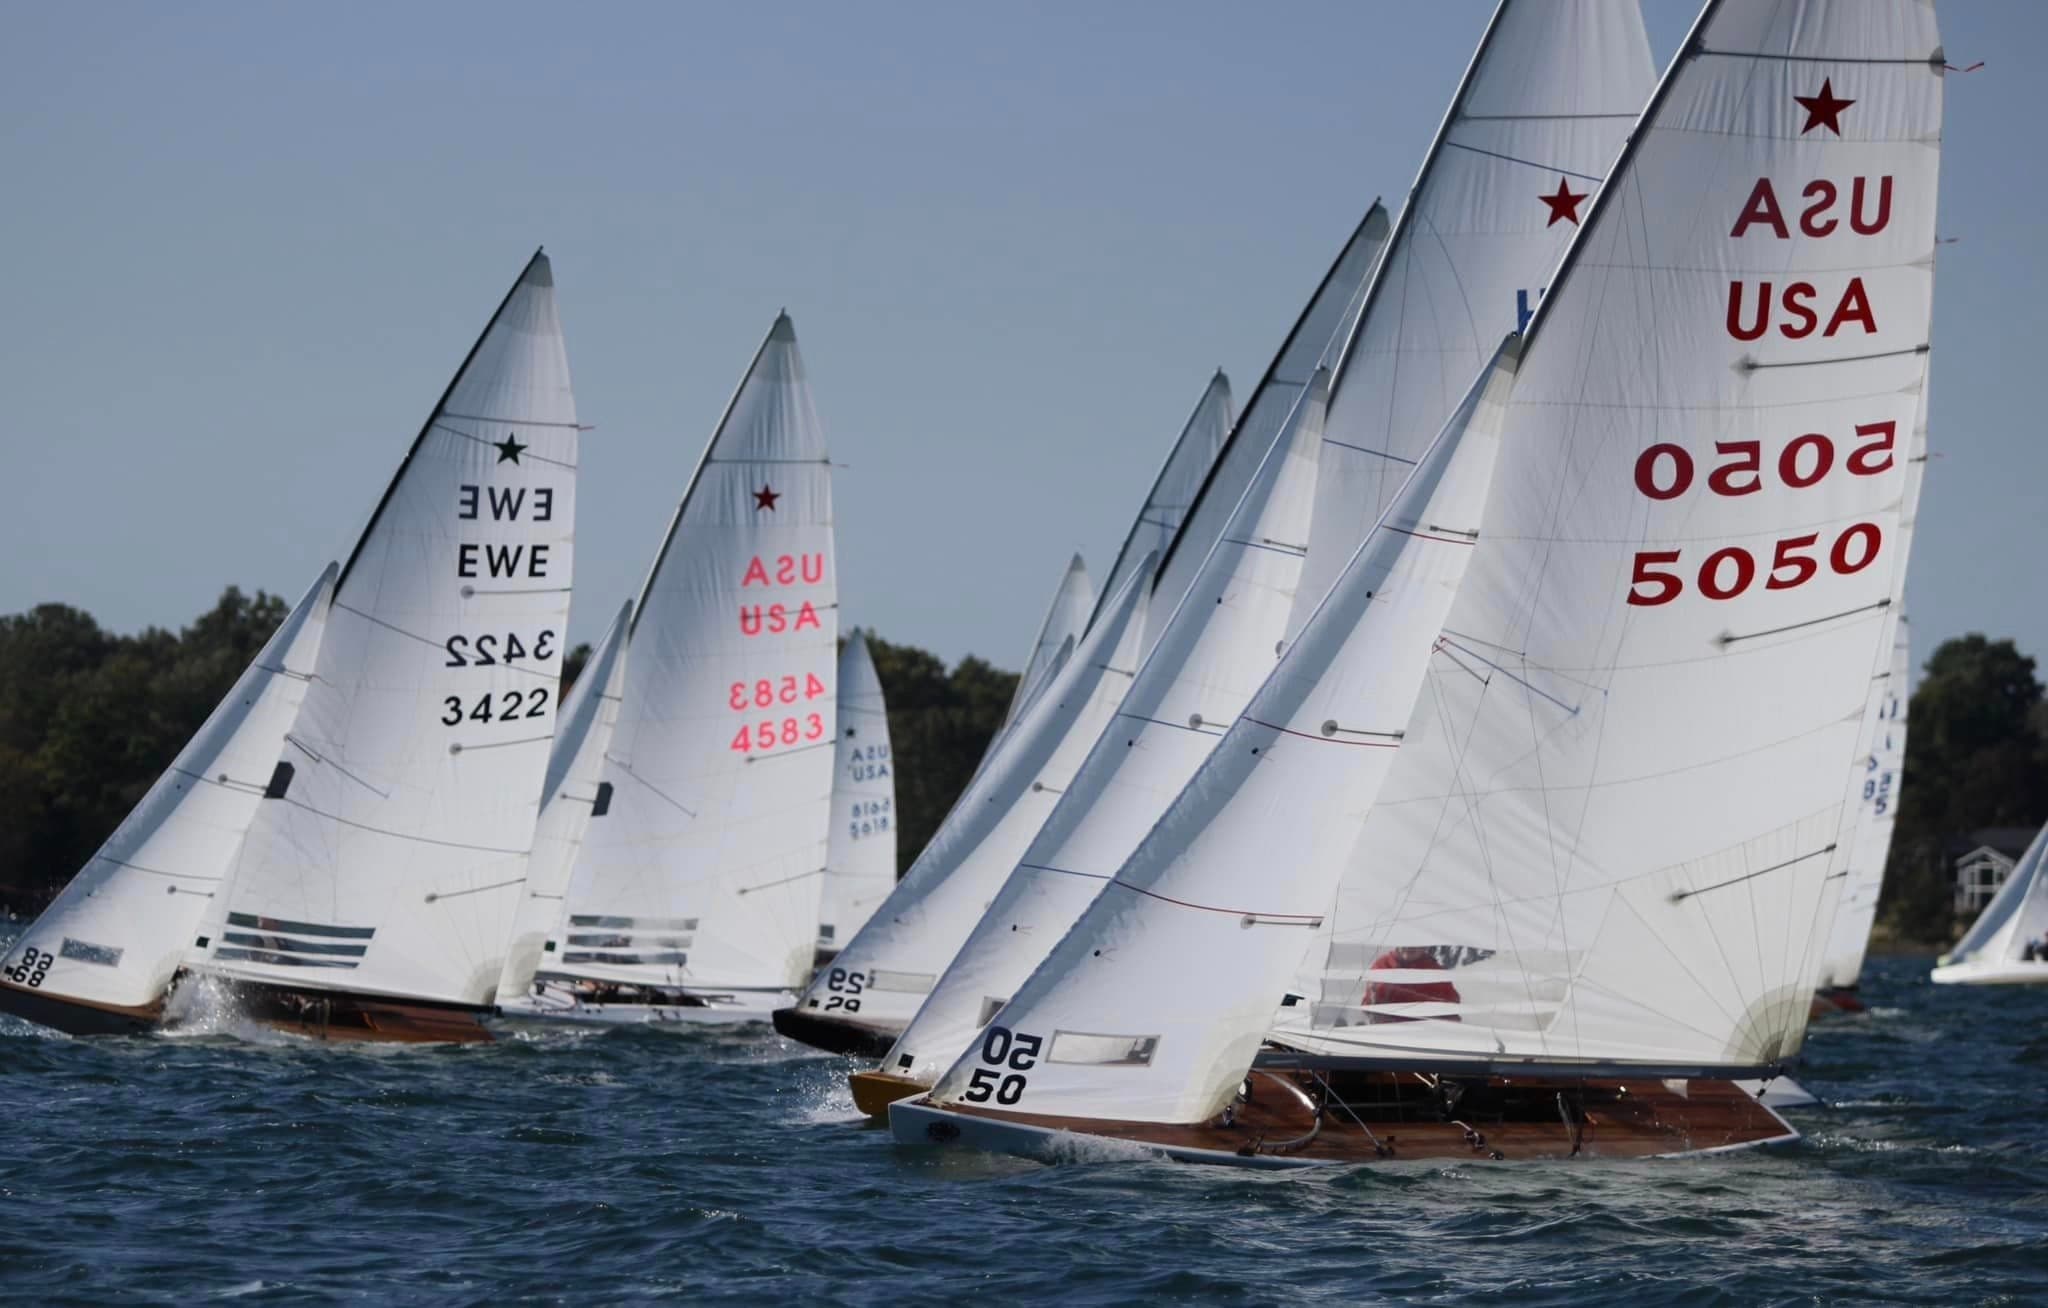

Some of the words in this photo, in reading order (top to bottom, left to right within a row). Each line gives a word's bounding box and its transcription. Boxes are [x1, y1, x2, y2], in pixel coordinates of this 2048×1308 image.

[1726, 276, 1878, 342] USA
[458, 543, 550, 578] EWE
[1625, 522, 1883, 607] 5050
[740, 601, 820, 635] USA
[441, 687, 549, 727] 3422
[731, 713, 823, 753] 4583
[852, 765, 890, 781] USA
[12, 966, 45, 987] 68
[965, 1068, 1027, 1105] 50
